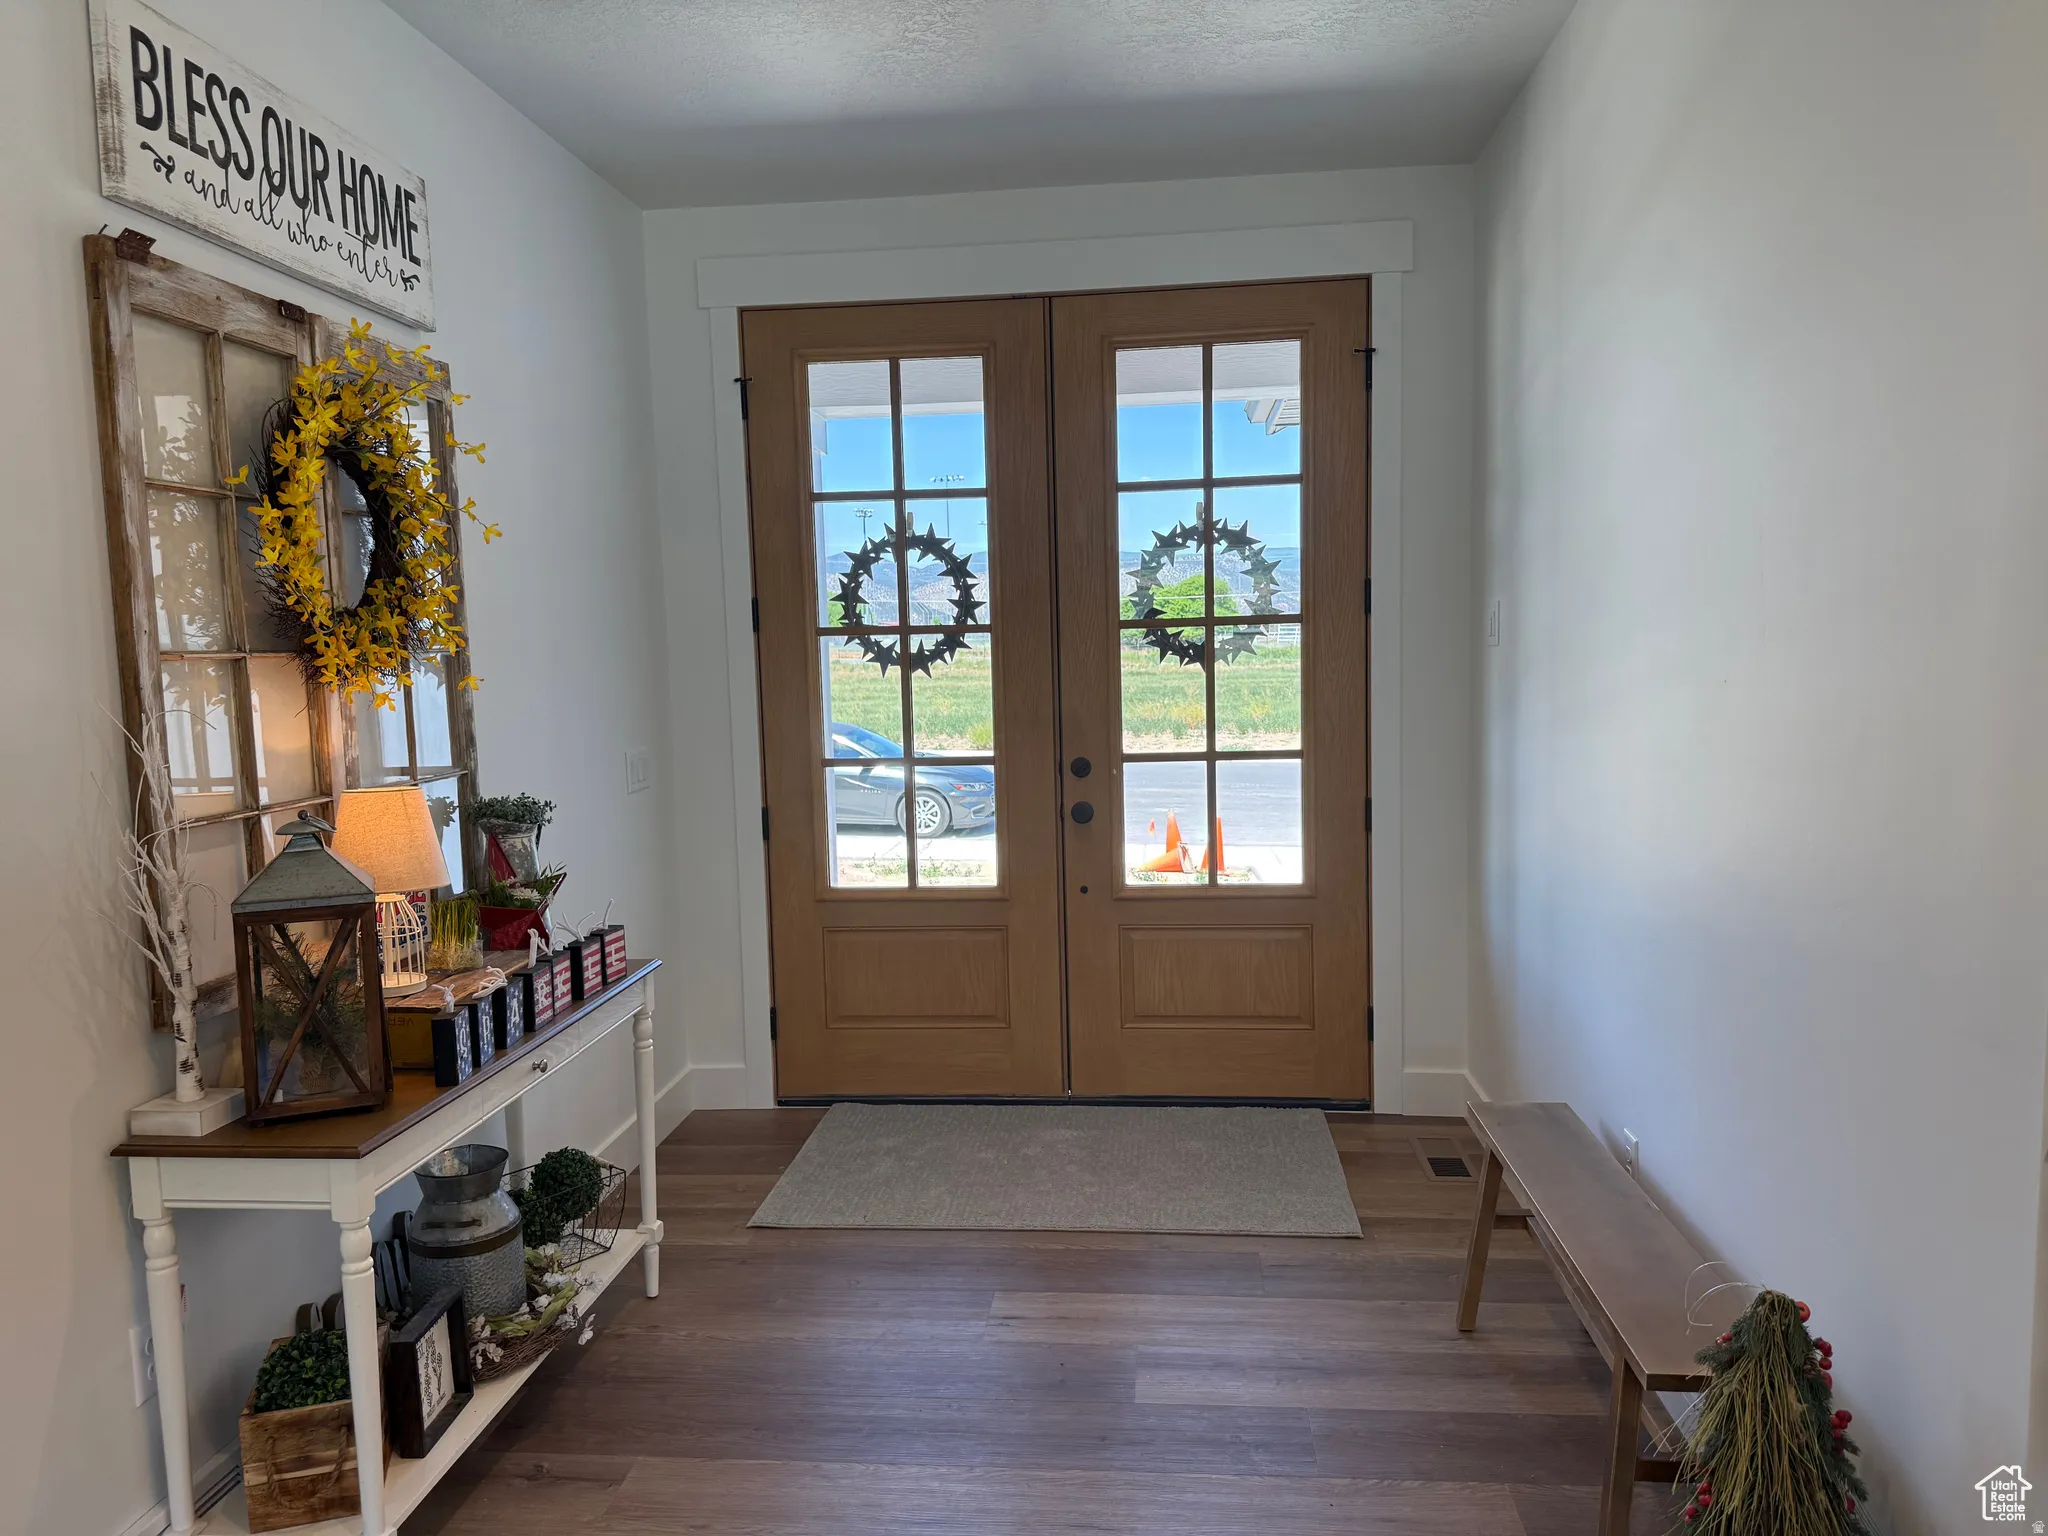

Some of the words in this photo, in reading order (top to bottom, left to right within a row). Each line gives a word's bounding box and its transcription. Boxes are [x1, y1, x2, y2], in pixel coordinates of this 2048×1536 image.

[130, 24, 254, 181] BLESS
[261, 105, 335, 224] OUR
[337, 148, 421, 268] HOME
[184, 166, 240, 214] and
[244, 166, 284, 230] all
[287, 198, 333, 253] who
[337, 230, 399, 288] enter
